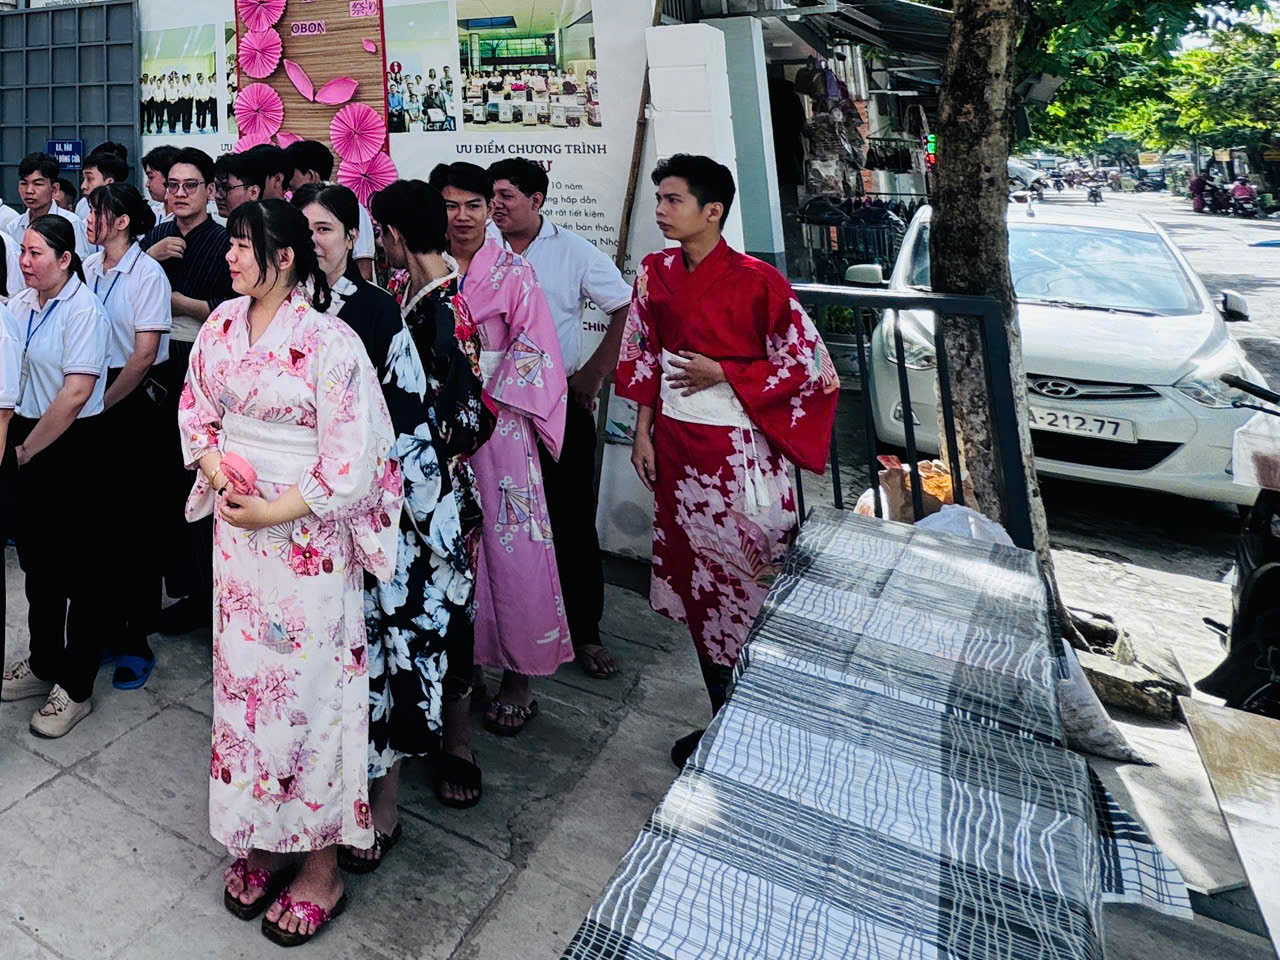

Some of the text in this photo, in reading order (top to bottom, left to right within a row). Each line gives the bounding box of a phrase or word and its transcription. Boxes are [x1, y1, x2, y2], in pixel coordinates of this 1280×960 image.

[291, 22, 326, 34] OBON
[475, 140, 505, 154] ĐIỂM
[508, 143, 561, 154] CHƯƠNG
[565, 142, 607, 154] TRÌNH
[551, 181, 562, 189] 10
[1028, 408, 1120, 436] A-212.77
